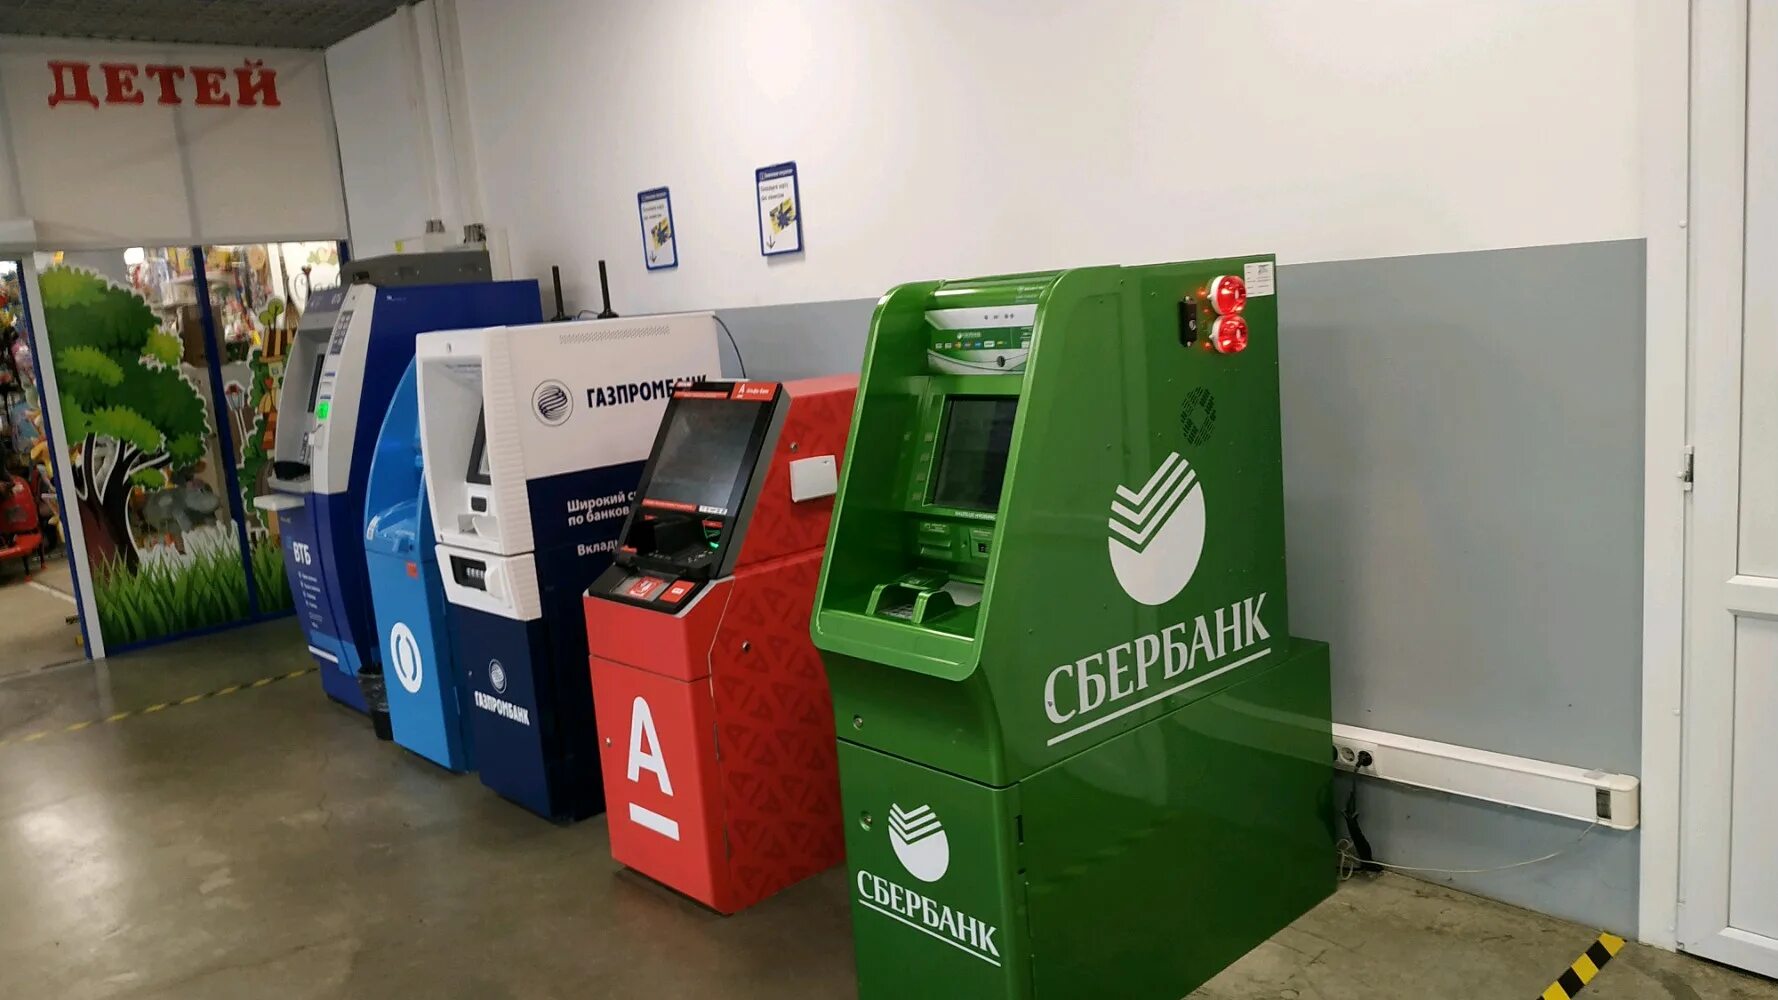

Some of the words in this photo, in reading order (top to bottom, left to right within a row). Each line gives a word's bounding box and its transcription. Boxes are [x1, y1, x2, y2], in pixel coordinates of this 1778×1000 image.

[48, 58, 281, 109] ДЕТЕЙ
[567, 491, 626, 513] Широкий
[568, 515, 584, 527] по
[292, 541, 312, 566] ВТБ
[1044, 592, 1271, 724] СБЕРБАНК
[474, 683, 530, 726] ГАЗПРОМБАНК
[627, 696, 674, 797] А
[857, 870, 1001, 957] СБЕРБАНК
